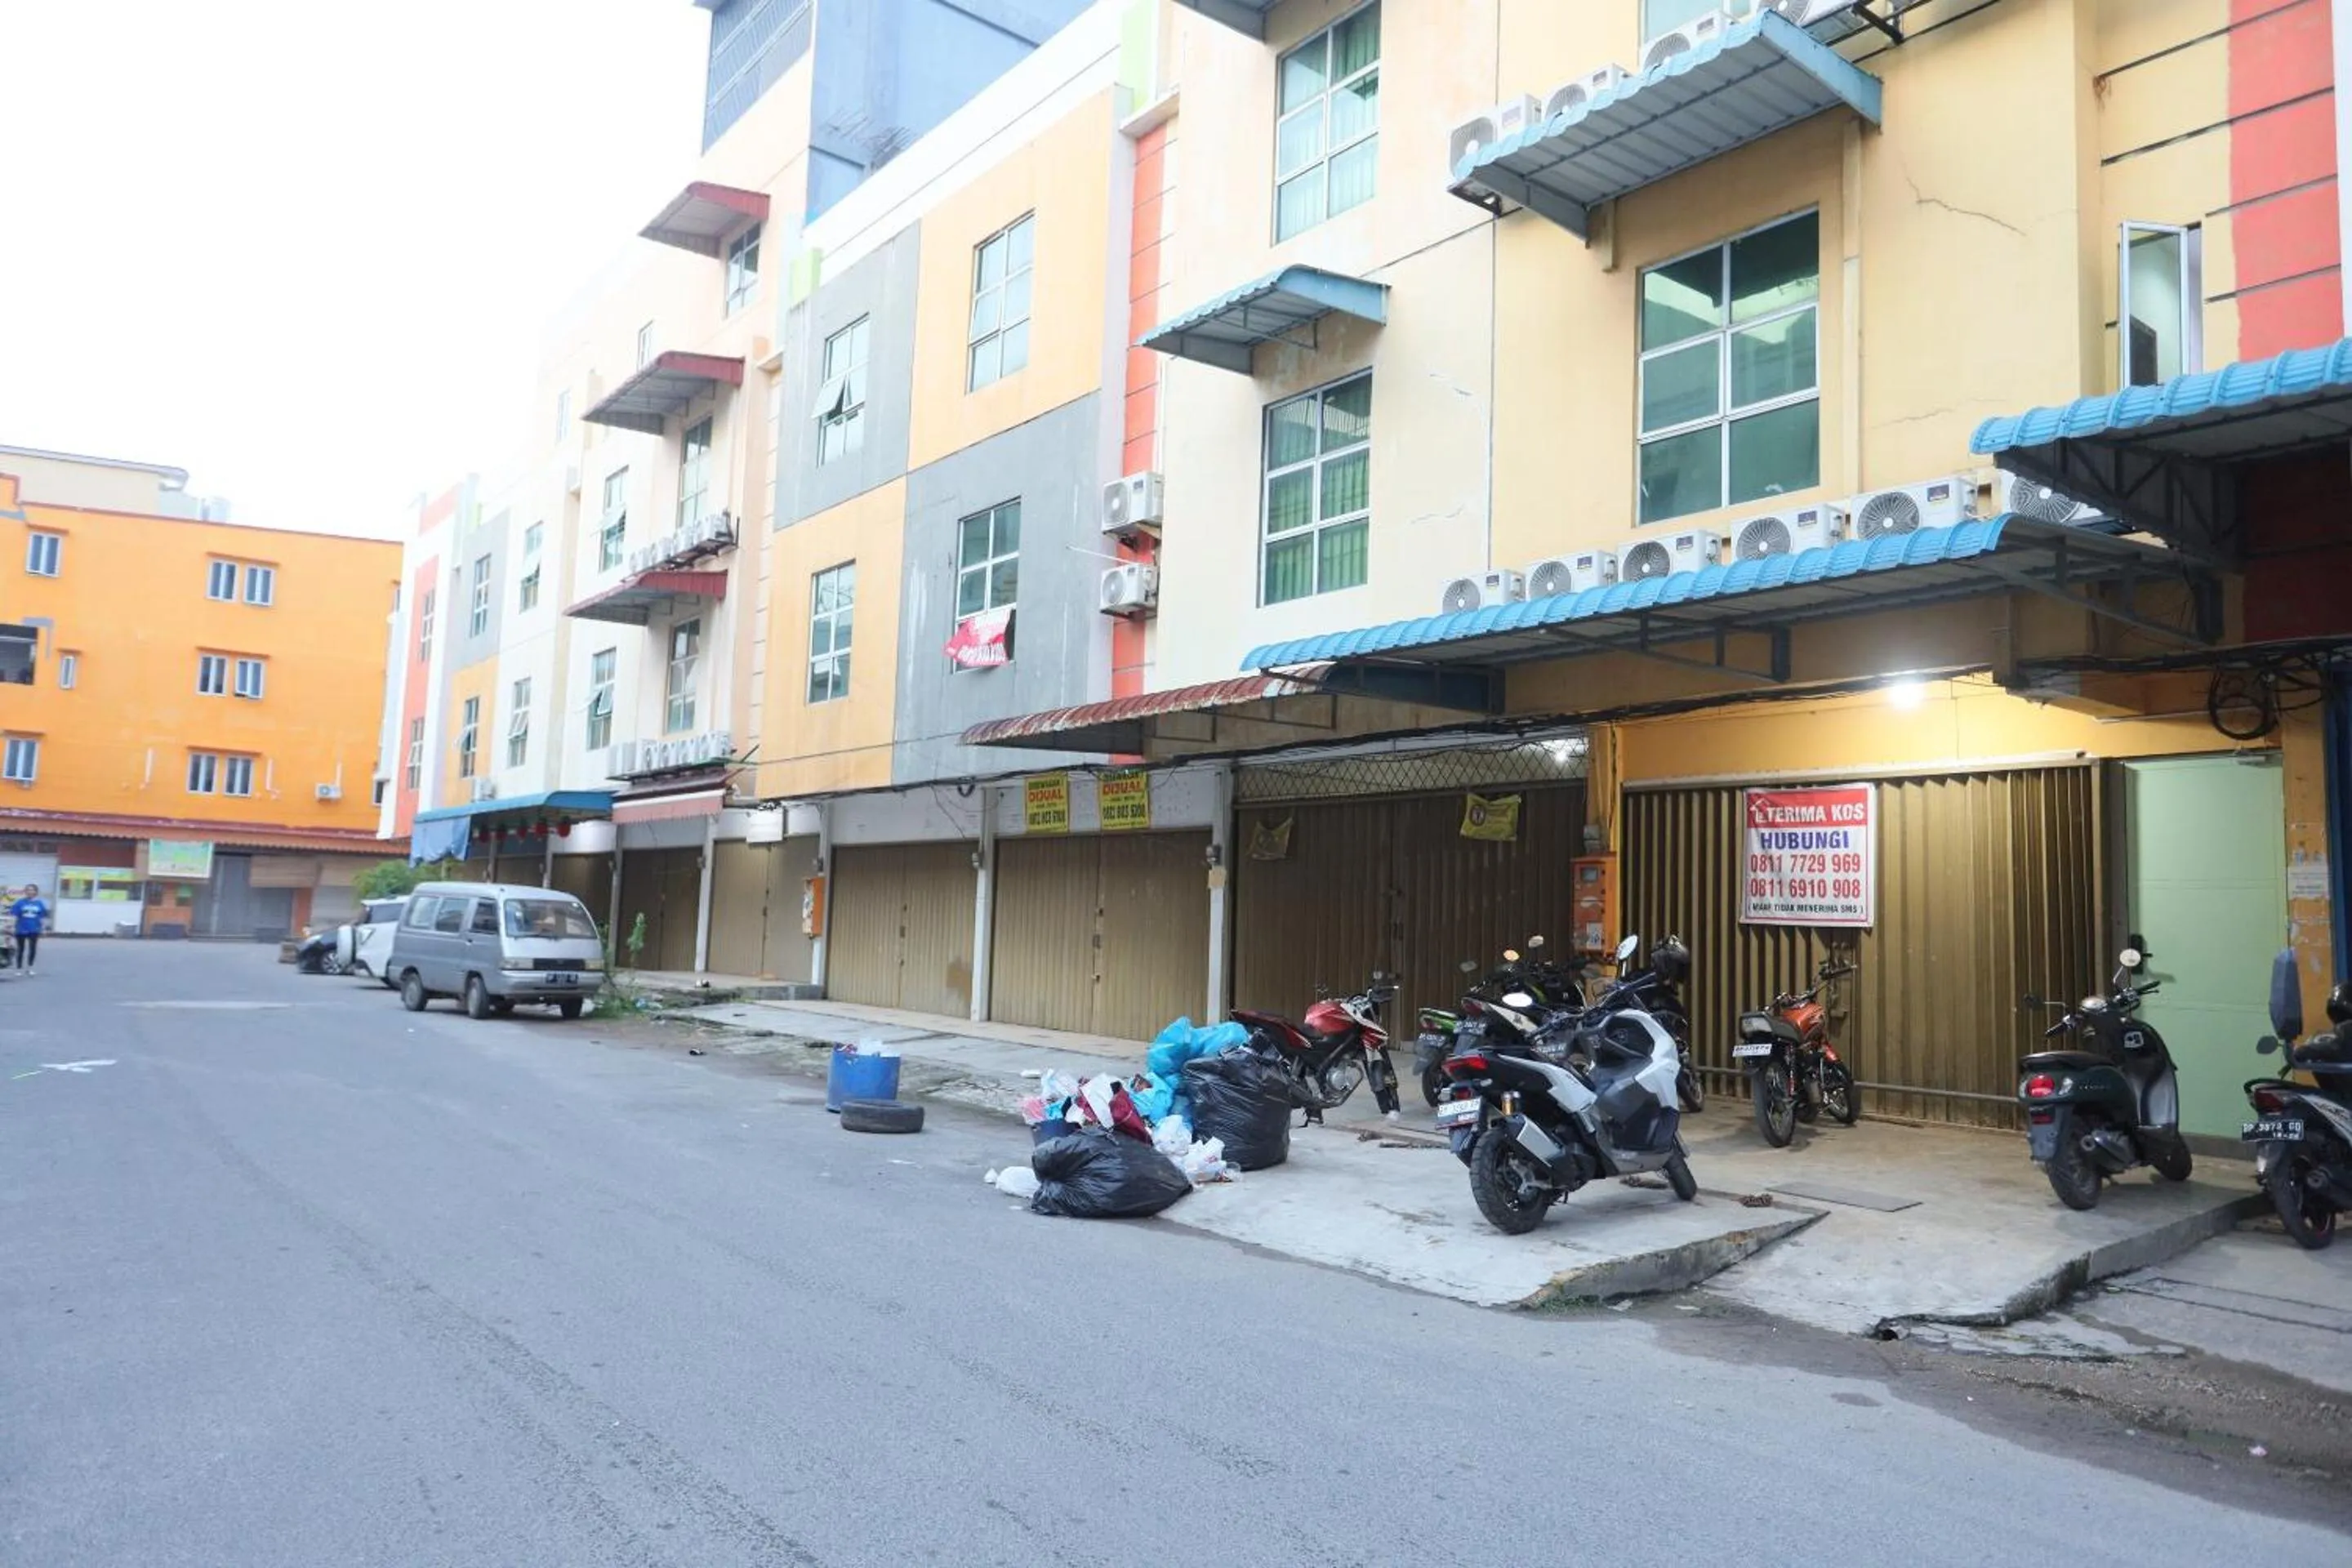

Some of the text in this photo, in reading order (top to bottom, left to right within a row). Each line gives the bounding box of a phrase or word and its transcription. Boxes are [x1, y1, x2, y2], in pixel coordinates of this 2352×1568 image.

[1102, 780, 1141, 796] DIJUAL
[1766, 803, 1864, 823] TERIMA KOS
[1761, 831, 1849, 849] HUBUNGI
[1751, 853, 1860, 873] 0811 7729 969
[1751, 878, 1860, 898] 0811 6910 908
[1840, 905, 1857, 913] SMS
